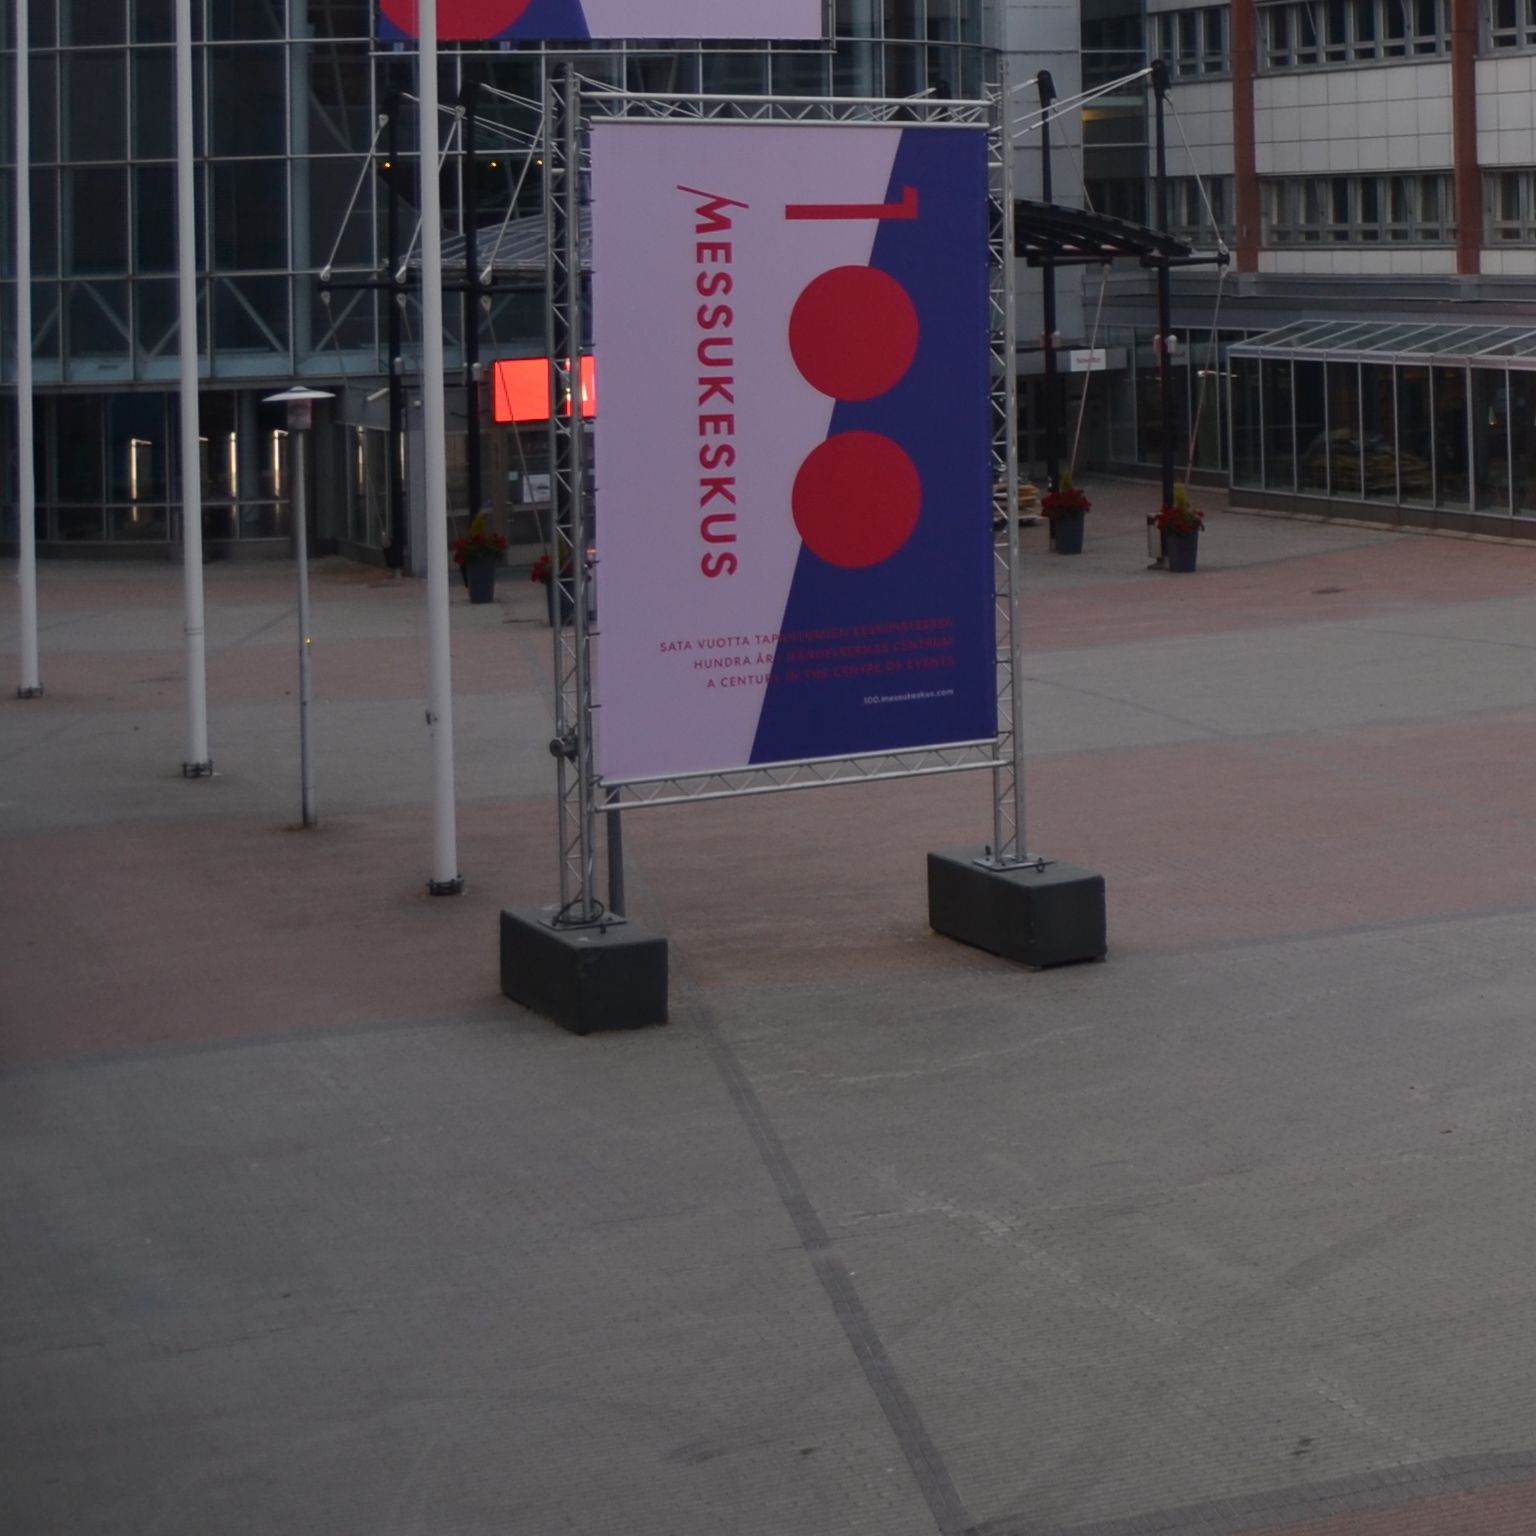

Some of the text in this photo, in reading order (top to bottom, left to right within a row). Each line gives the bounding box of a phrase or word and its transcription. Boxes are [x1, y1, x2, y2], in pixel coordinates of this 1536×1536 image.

[676, 184, 750, 578] MESSUKESKUS
[660, 640, 692, 653] SATA
[697, 636, 751, 650] VUOTTA
[694, 655, 751, 670] HUNDRA
[756, 651, 773, 665] ÅR
[707, 677, 716, 689] A
